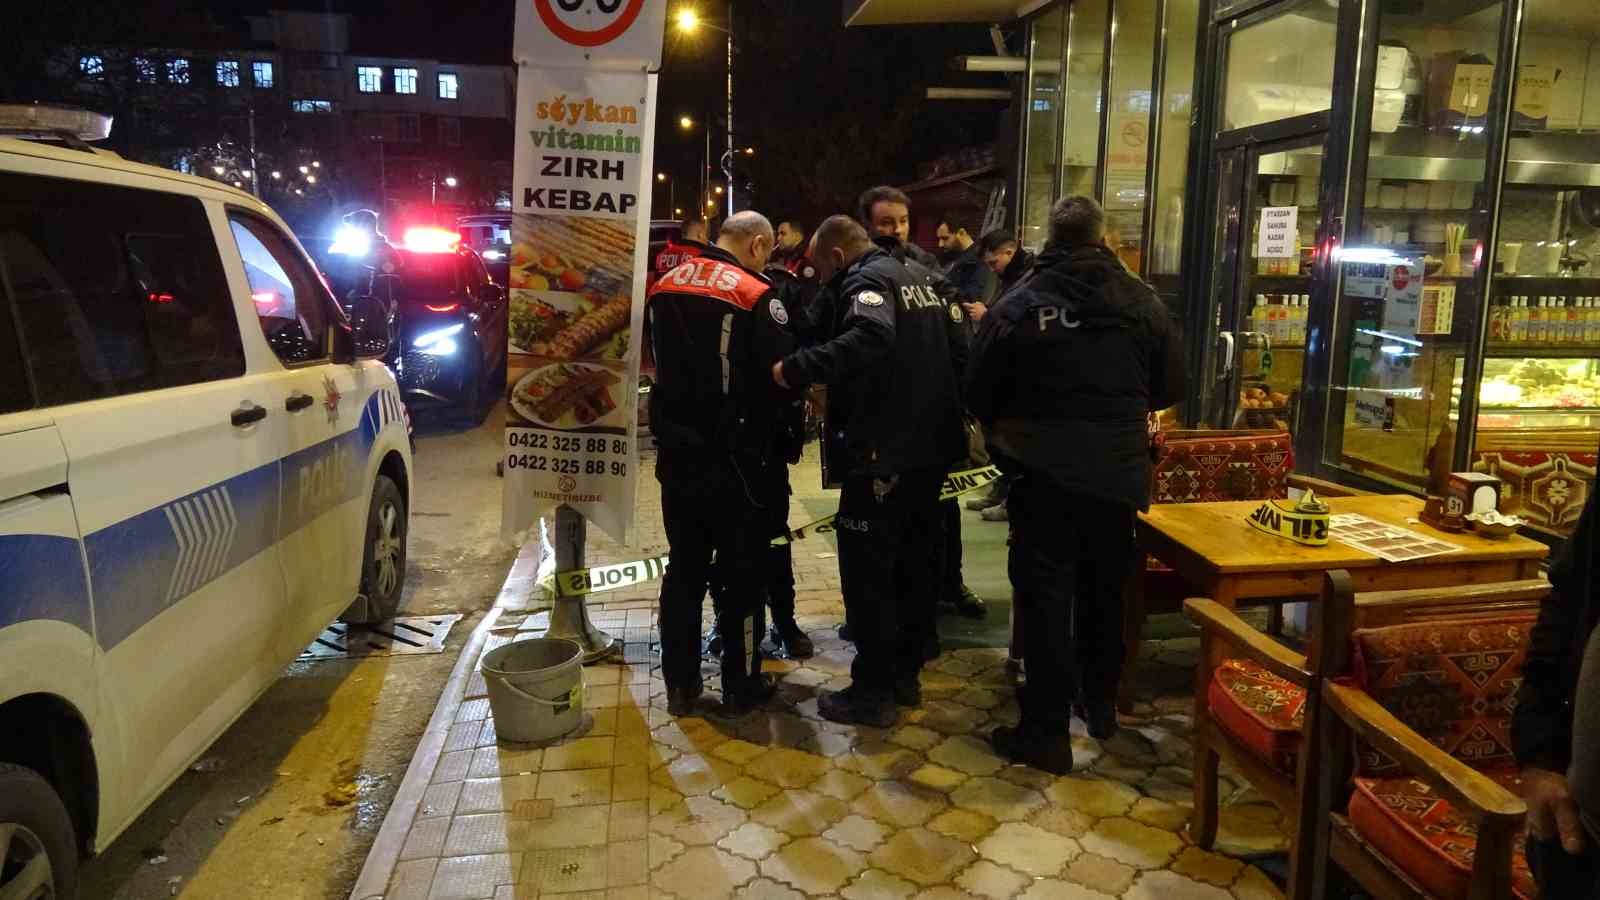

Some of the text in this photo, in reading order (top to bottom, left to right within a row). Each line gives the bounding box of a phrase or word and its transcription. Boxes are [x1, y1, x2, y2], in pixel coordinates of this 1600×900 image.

[530, 126, 641, 153] vitamin
[541, 156, 625, 181] ZIRH
[523, 187, 637, 214] KEBAP
[509, 432, 627, 455] 0422 325 88 80
[508, 454, 626, 477] 0422 325 88 90
